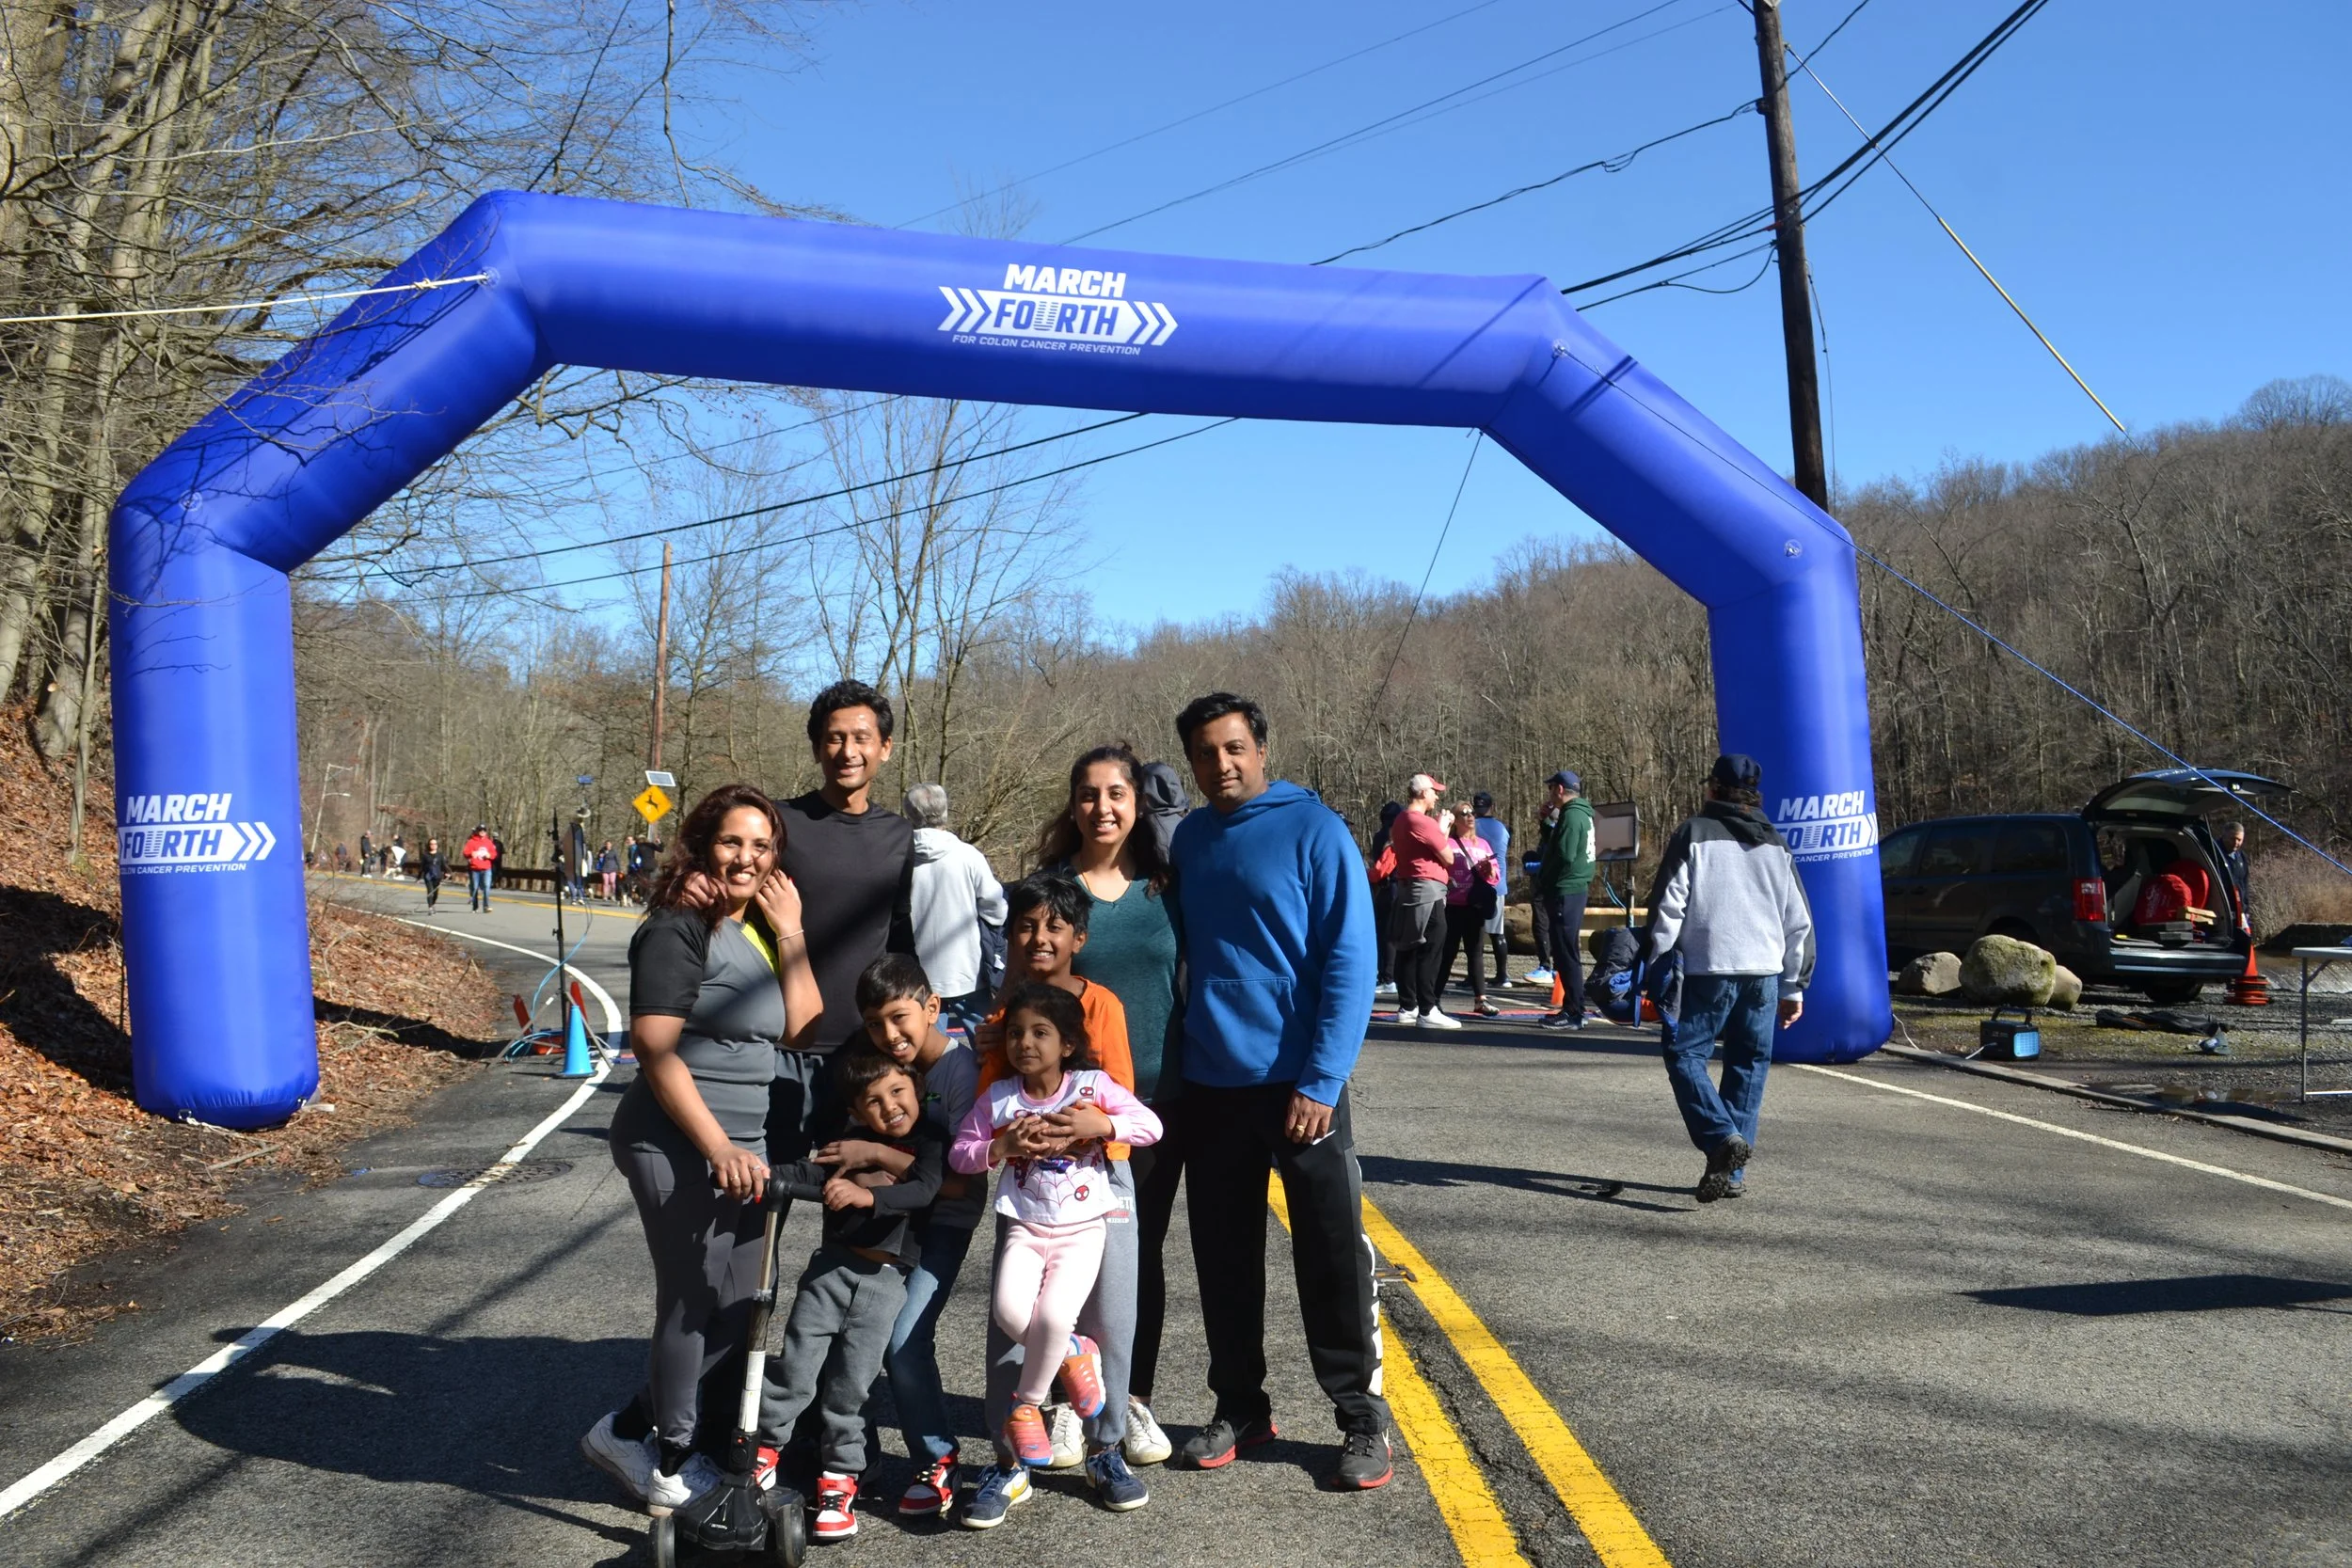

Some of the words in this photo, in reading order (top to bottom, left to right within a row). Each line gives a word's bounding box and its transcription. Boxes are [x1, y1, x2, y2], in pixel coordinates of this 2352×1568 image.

[1003, 263, 1127, 298] MARCH
[993, 298, 1119, 336] FOURTH
[952, 334, 976, 344] FOR
[979, 336, 1018, 348] COLON
[1021, 340, 1067, 351] CANCER
[1069, 342, 1141, 356] PREVENTION
[125, 793, 232, 824] MARCH
[1777, 790, 1865, 821] MARCH
[122, 829, 223, 859] FOURTH
[1794, 852, 1830, 863] CANCER
[136, 865, 172, 874] CANCER
[174, 863, 246, 873] PREVENTION
